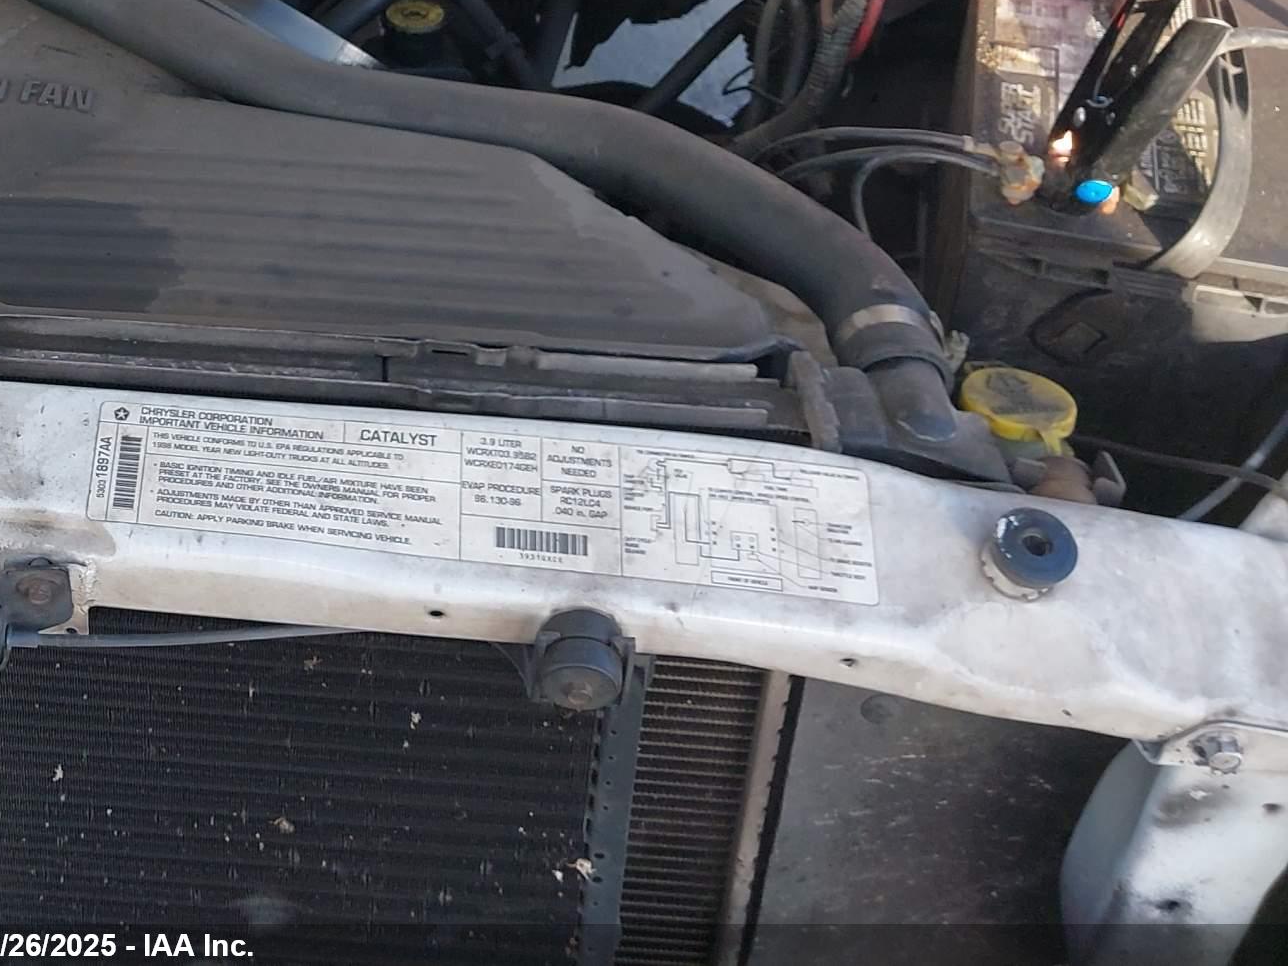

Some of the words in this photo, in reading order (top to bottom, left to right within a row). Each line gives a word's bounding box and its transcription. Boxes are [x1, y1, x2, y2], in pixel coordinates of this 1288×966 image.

[20, 81, 94, 114] FAN
[139, 415, 200, 429] IMPORTANT
[203, 421, 246, 433] VEHICLE
[250, 425, 324, 439] INFORMATION
[141, 406, 197, 419] CHRYSLER
[198, 411, 272, 426] CORPORATION
[172, 434, 201, 442] VEHICLE
[203, 436, 245, 446] CONFORMS
[247, 440, 257, 448] TO
[293, 444, 344, 455] REGULATIONS
[347, 449, 391, 460] APPLICABLE
[393, 453, 404, 461] TO
[360, 429, 437, 447] CATALYST
[498, 439, 522, 448] LITER
[173, 443, 200, 452] MODEL
[288, 455, 318, 463] TRUCKS
[332, 457, 345, 465] ALL
[546, 454, 612, 467] ADJUSTMENTS
[571, 445, 585, 454] NO
[159, 461, 184, 469] BASIC
[186, 464, 222, 473] IGNITION
[225, 467, 254, 475] TIMING
[257, 470, 275, 478] AND
[277, 472, 295, 480] IDLE
[297, 474, 337, 484] FUEL/AIR
[340, 478, 377, 489] MIXTURE
[380, 483, 403, 492] HAVE
[405, 485, 428, 494] BEEN
[561, 467, 596, 477] NEEDED
[158, 476, 212, 486] PROCEDURES
[215, 481, 233, 489] AND
[236, 483, 263, 492] OTHER
[266, 486, 316, 498] ADDITIONAL
[159, 469, 190, 478] PRESET
[342, 487, 380, 497] MANUAL
[382, 490, 399, 499] FOR
[401, 492, 436, 502] PROPER
[462, 481, 485, 489] EVAP
[488, 483, 541, 496] PROCEDURE
[550, 486, 581, 496] SPARK
[582, 489, 612, 498] PLUGS
[156, 495, 212, 507] PROCEDURES
[236, 503, 270, 513] VIOLATE
[272, 506, 309, 518] FEDERAL
[312, 511, 331, 520] AND
[333, 514, 360, 523] STATE
[157, 488, 219, 500] ADJUSTMENTS
[221, 494, 247, 503] MADE
[248, 497, 261, 505] BY
[262, 499, 290, 508] OTHER
[293, 502, 317, 510] THAN
[319, 504, 364, 516] APPROVED
[367, 510, 402, 520] SERVICE
[404, 514, 443, 525] MANUAL
[588, 511, 608, 519] GAP
[197, 514, 225, 522] APPLY
[226, 516, 264, 527] PARKING
[266, 520, 295, 530] BRAKE
[297, 524, 324, 533] WHEN
[327, 527, 372, 540] SERVICING
